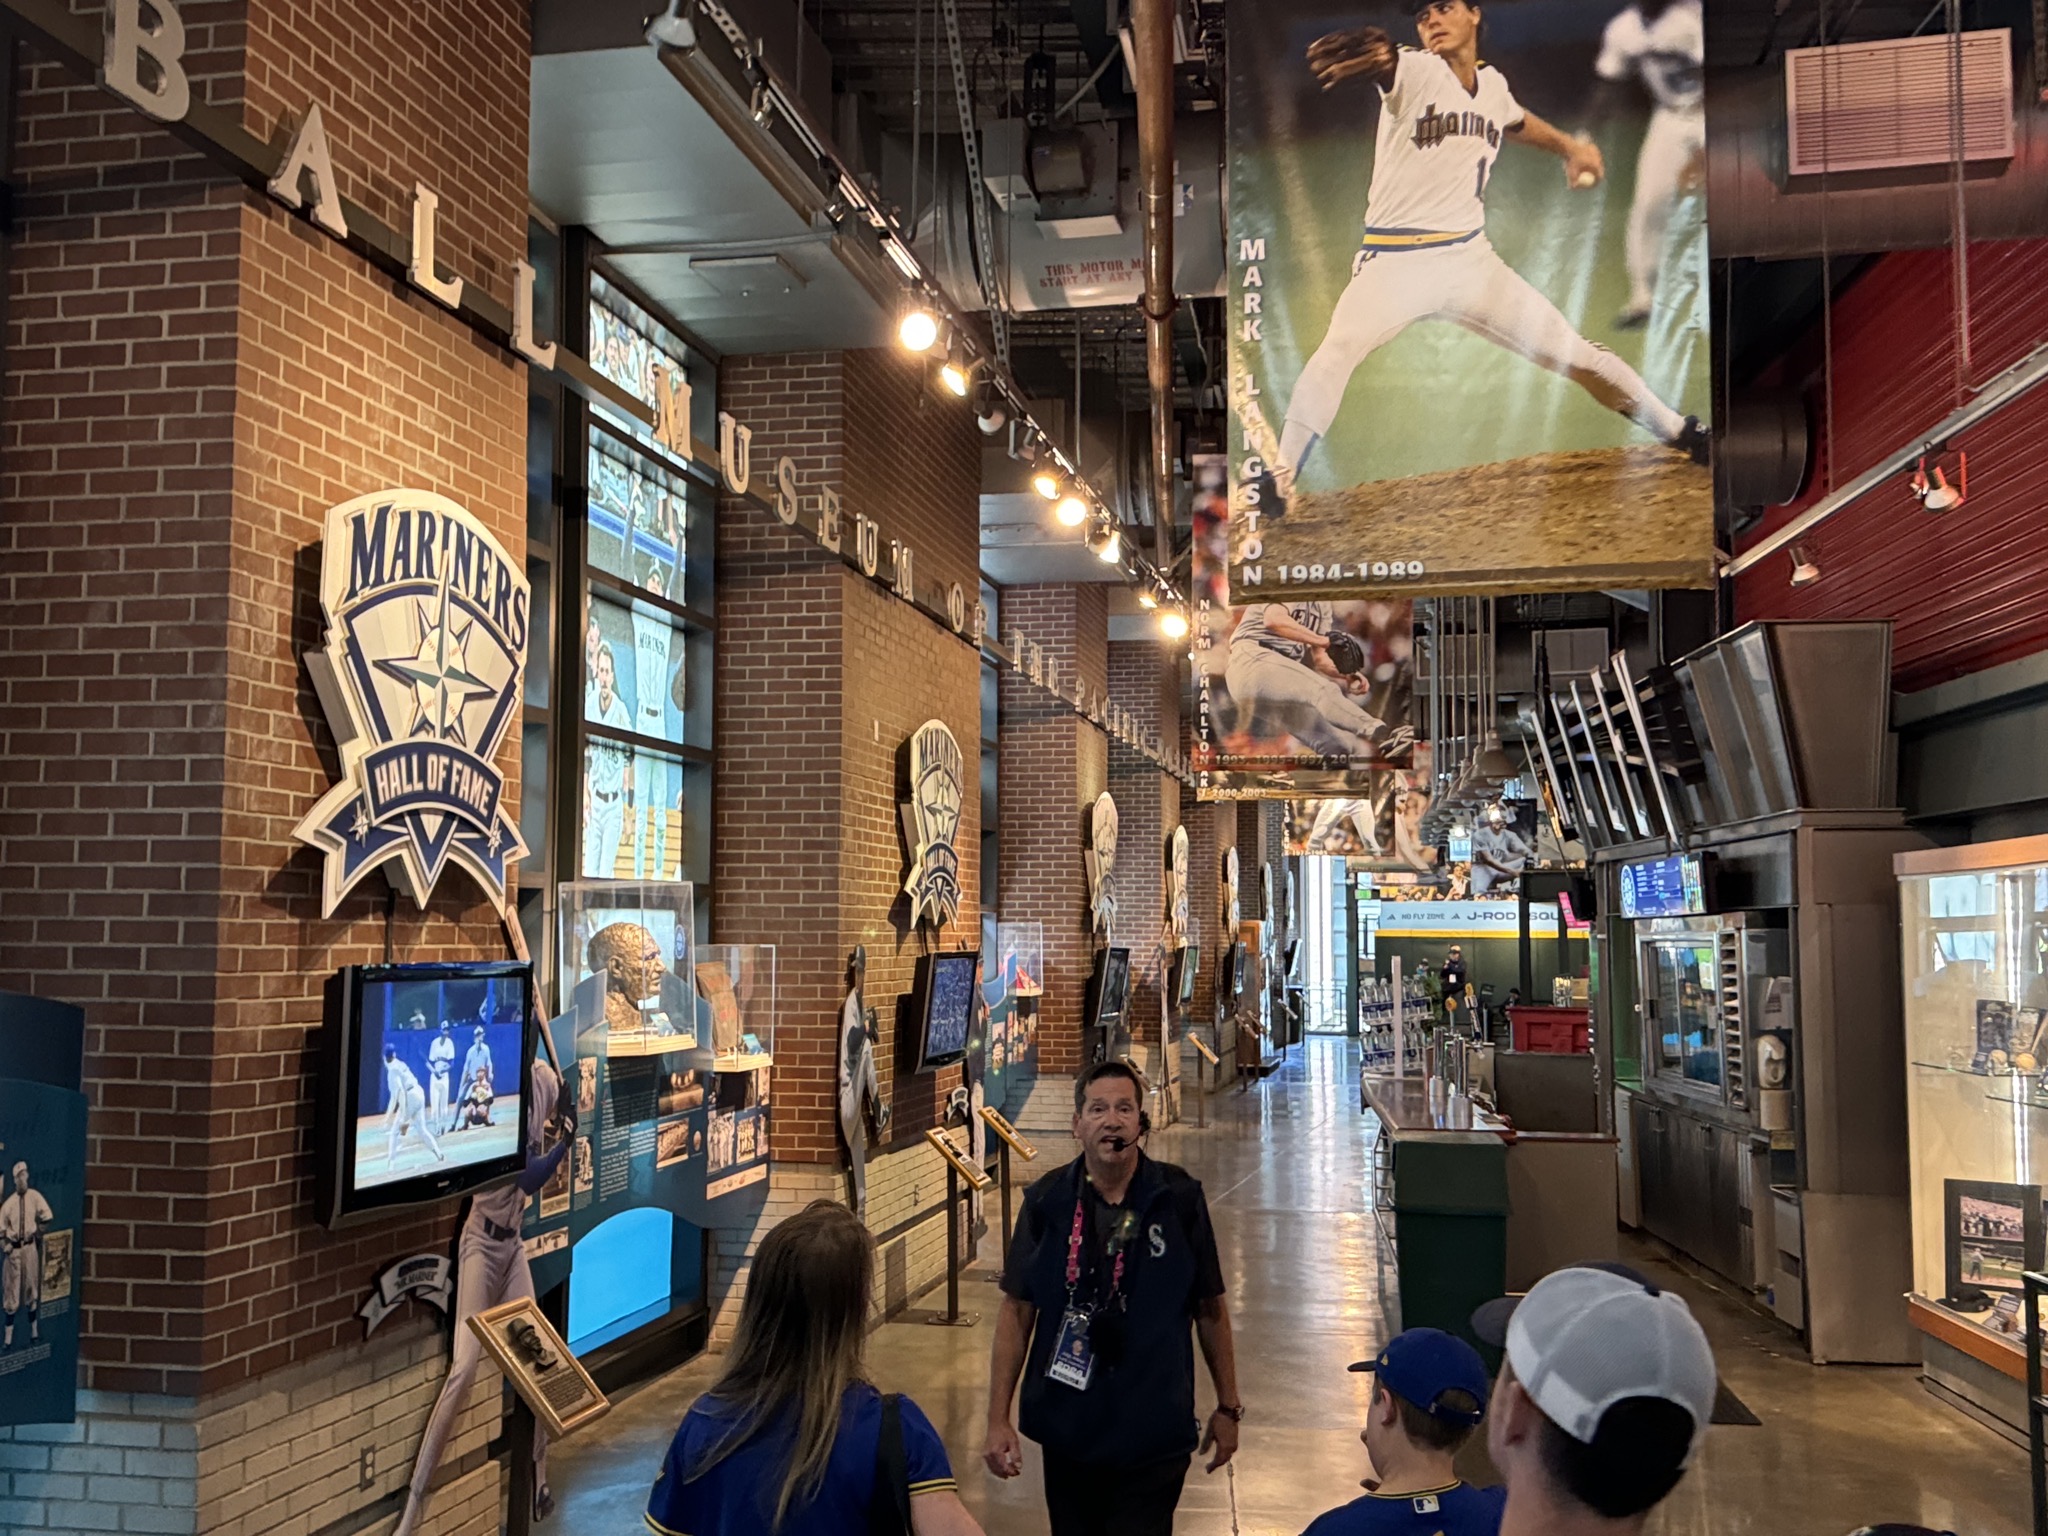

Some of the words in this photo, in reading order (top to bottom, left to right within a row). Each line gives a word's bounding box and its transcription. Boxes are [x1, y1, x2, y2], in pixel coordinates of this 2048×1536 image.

[1039, 275, 1078, 288] START
[1086, 273, 1101, 285] AT
[1109, 271, 1133, 283] ANY
[1045, 263, 1074, 277] THIS
[1080, 259, 1125, 274] MOTOR
[1238, 237, 1266, 342] MARK
[1240, 373, 1265, 587] LANGSTON
[652, 363, 914, 603] MUSEUM
[948, 581, 987, 646] OF
[1012, 628, 1060, 697] THE
[342, 503, 528, 652] MARINERS
[1277, 560, 1425, 586] 1984-1989
[1199, 599, 1212, 650] NORM
[1199, 663, 1211, 765] CHARLTON
[1331, 753, 1356, 766] 200
[375, 753, 424, 806] HALL
[426, 754, 450, 793] OF
[450, 757, 494, 819] FAME
[1467, 911, 1517, 921] J-ROD
[1529, 911, 1559, 922] SQU
[1148, 1223, 1167, 1259] S
